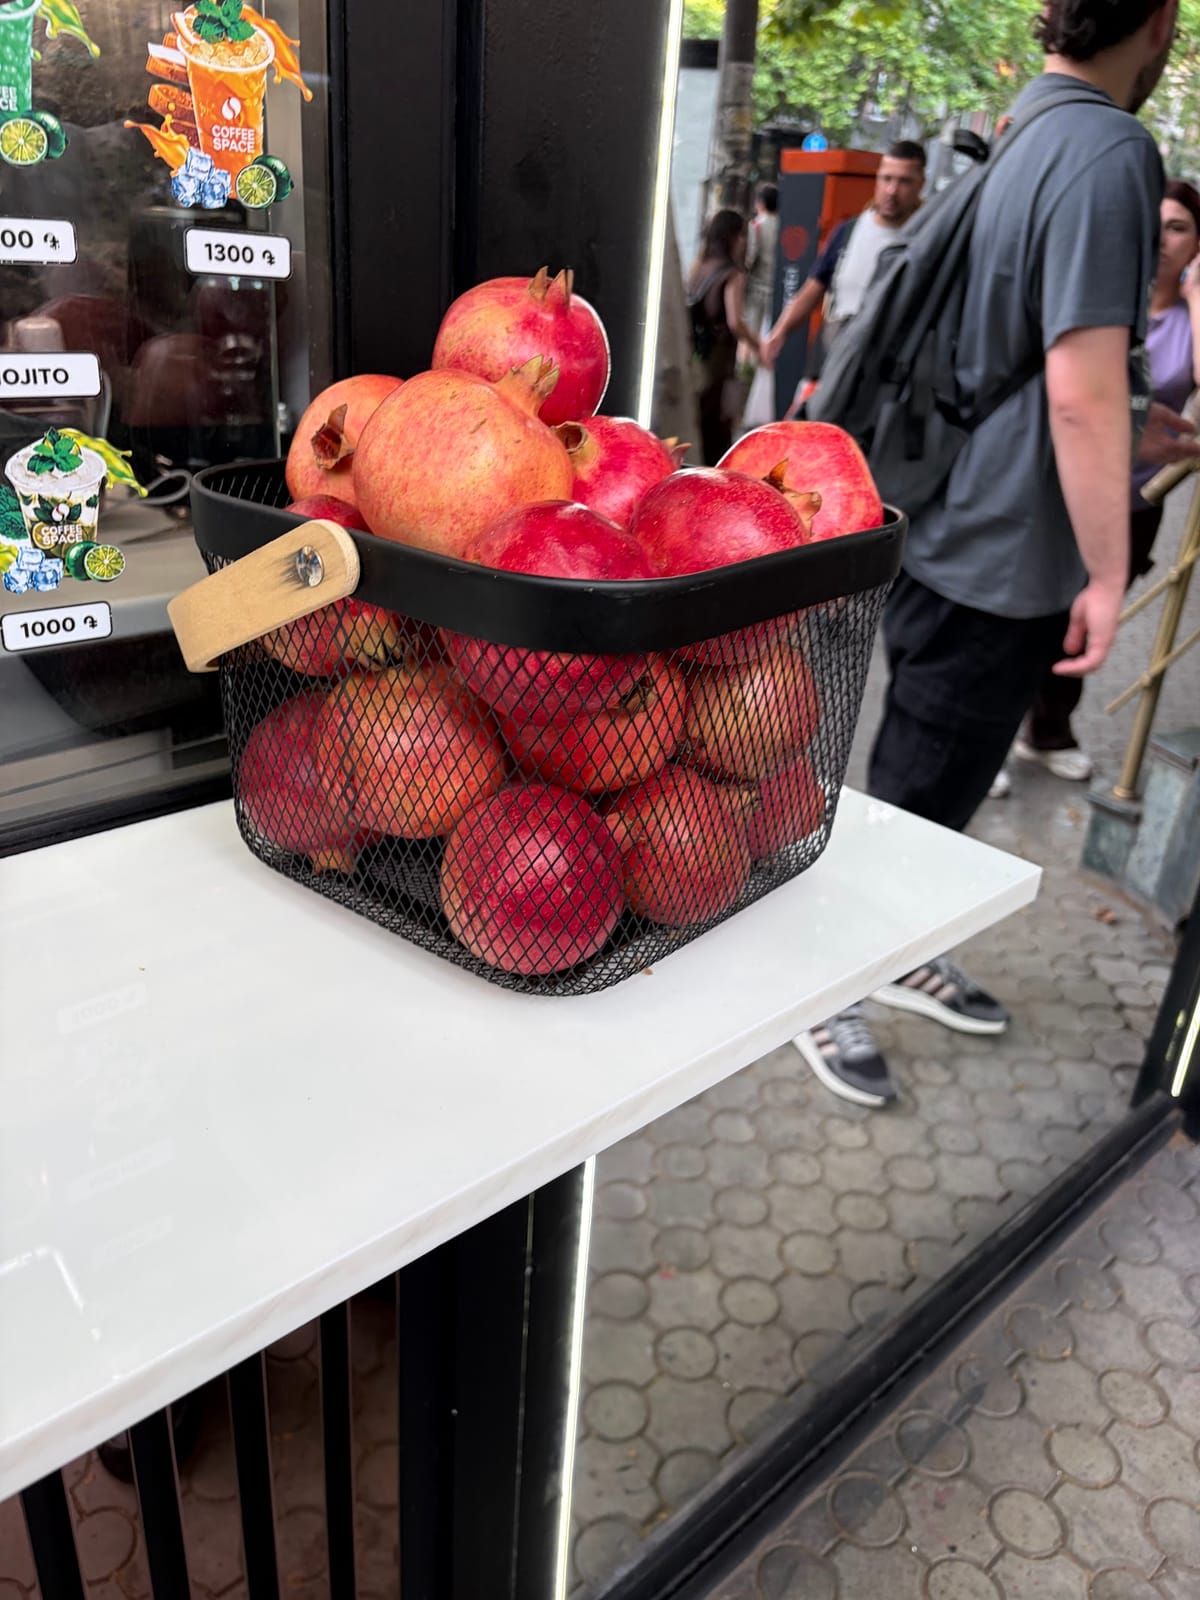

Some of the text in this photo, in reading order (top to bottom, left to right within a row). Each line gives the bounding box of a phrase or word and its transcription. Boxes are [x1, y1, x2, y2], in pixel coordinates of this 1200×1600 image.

[212, 124, 255, 140] COFFEE
[213, 137, 255, 153] SPACE
[204, 243, 254, 264] 1300
[0, 368, 69, 385] OJITO
[41, 524, 83, 535] COFFEE
[43, 533, 83, 545] SPACE
[20, 617, 75, 638] 1000
